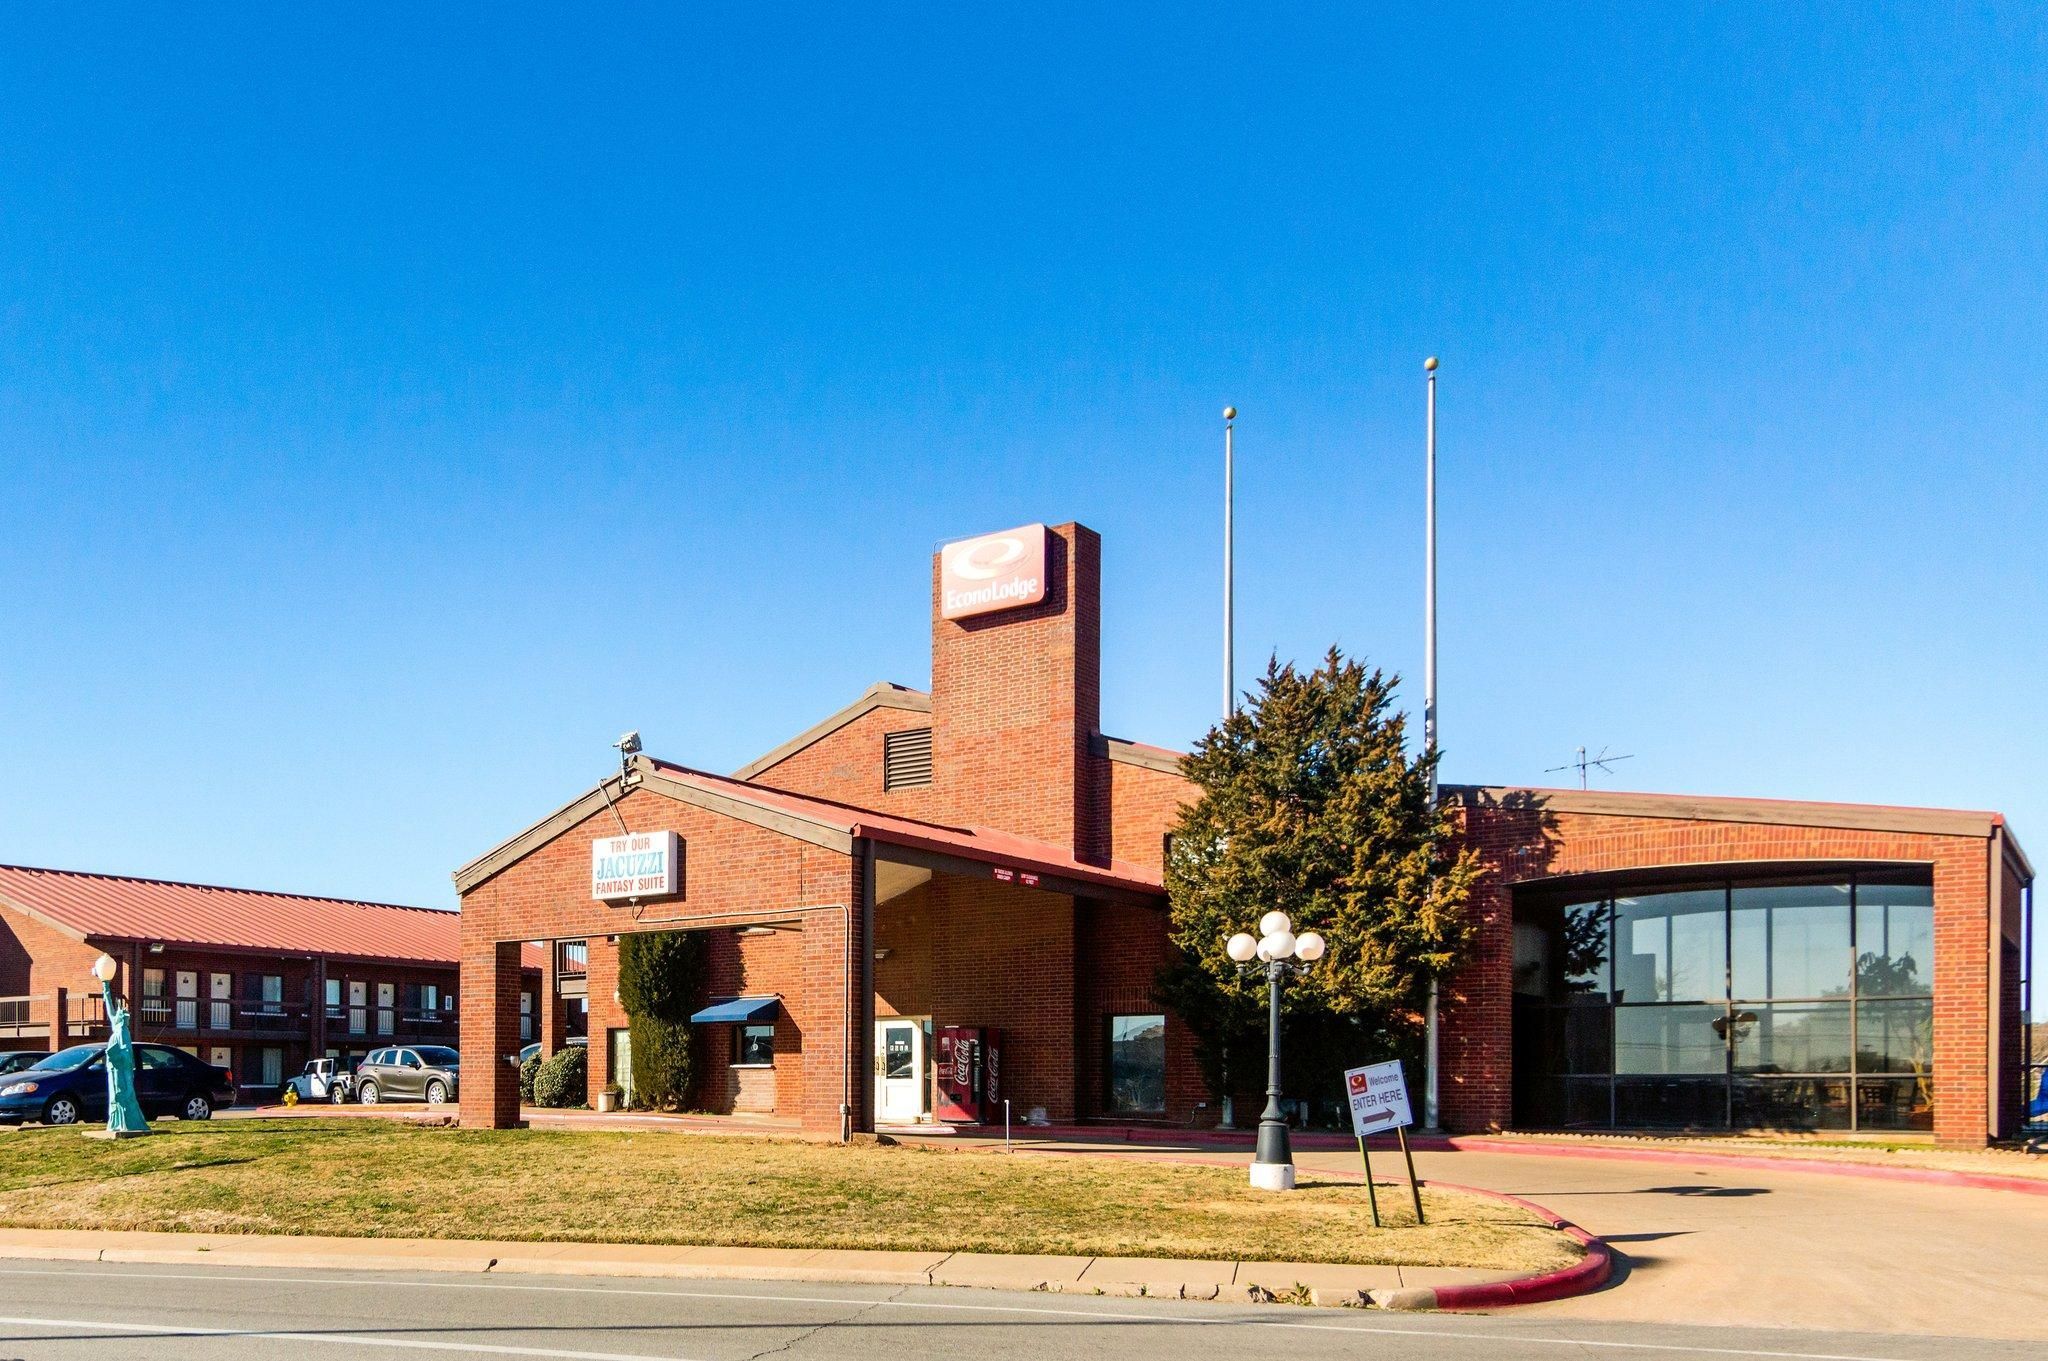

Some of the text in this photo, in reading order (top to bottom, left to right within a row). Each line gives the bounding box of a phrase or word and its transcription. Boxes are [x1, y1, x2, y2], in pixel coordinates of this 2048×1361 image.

[610, 837, 650, 853] TRY OUR
[597, 852, 664, 880] JACUZZI
[596, 876, 665, 894] FANTASY SUITE
[1368, 1074, 1399, 1087] Welcome
[1352, 1095, 1378, 1111] ENTER
[1378, 1089, 1403, 1104] HERE
